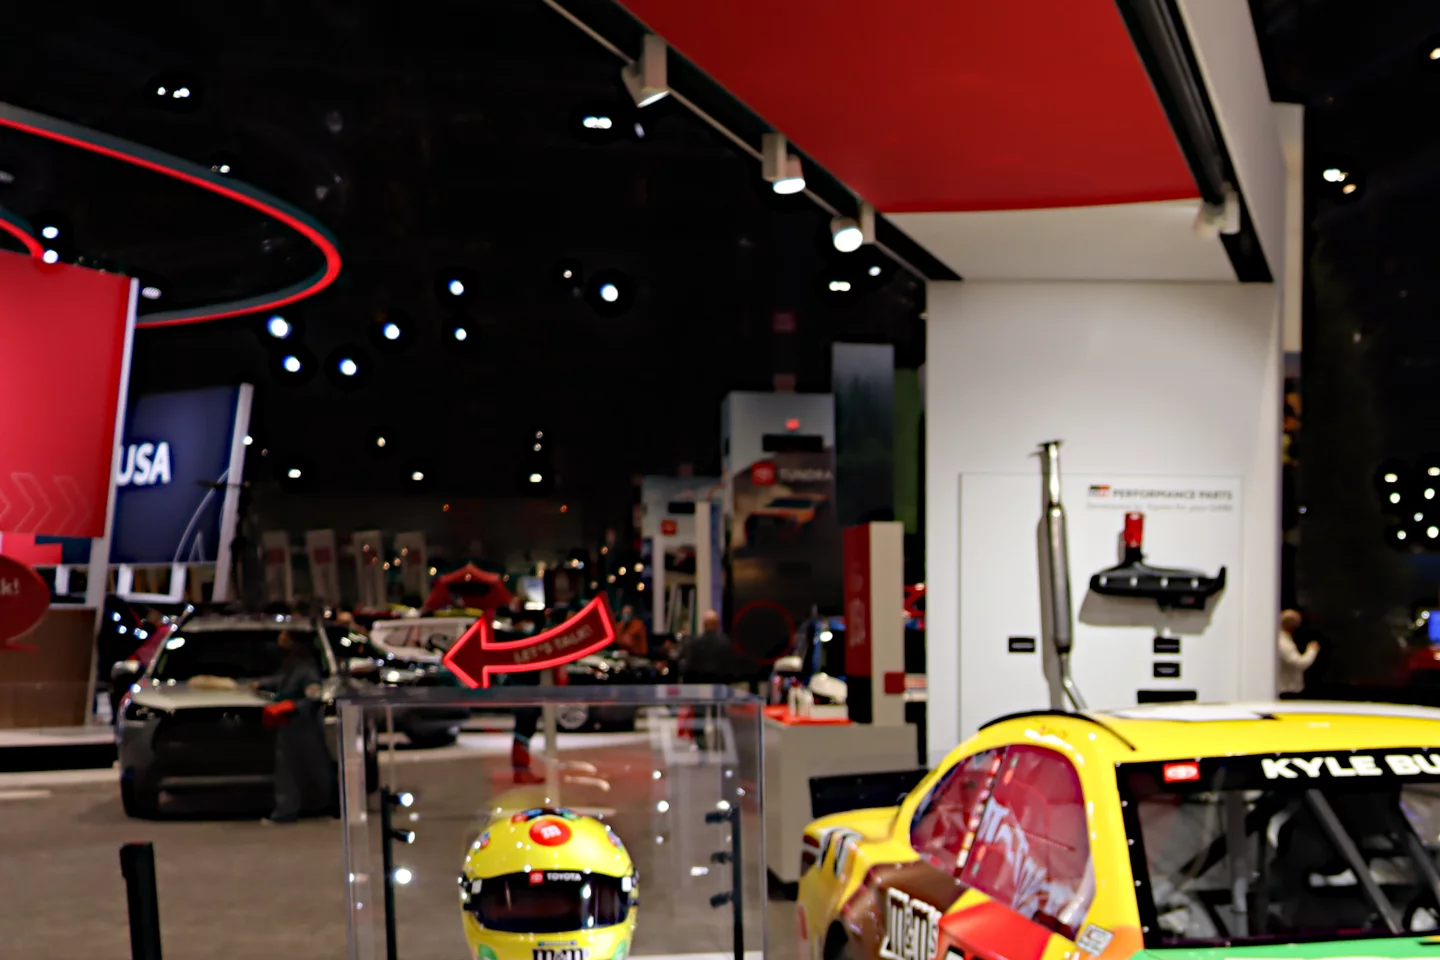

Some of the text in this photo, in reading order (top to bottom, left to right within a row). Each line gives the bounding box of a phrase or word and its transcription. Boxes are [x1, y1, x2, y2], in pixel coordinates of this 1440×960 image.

[117, 441, 171, 486] USA
[1261, 757, 1383, 780] KYLE
[546, 872, 582, 882] TOYOTA
